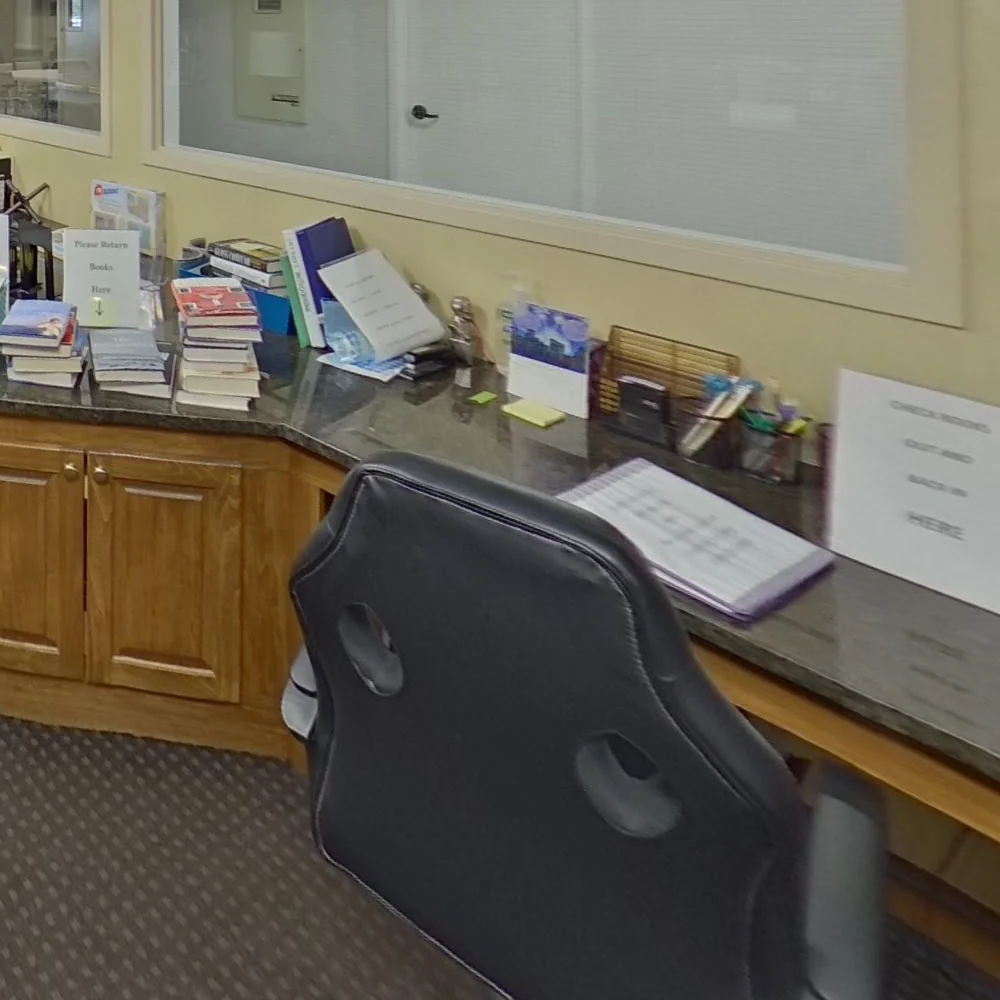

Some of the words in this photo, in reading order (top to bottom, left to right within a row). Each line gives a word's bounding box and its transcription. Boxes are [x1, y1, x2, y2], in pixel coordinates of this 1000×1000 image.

[74, 240, 98, 249] Please
[100, 240, 129, 250] Return
[89, 262, 114, 272] Books
[91, 285, 111, 295] Here
[906, 509, 967, 542] HERE
